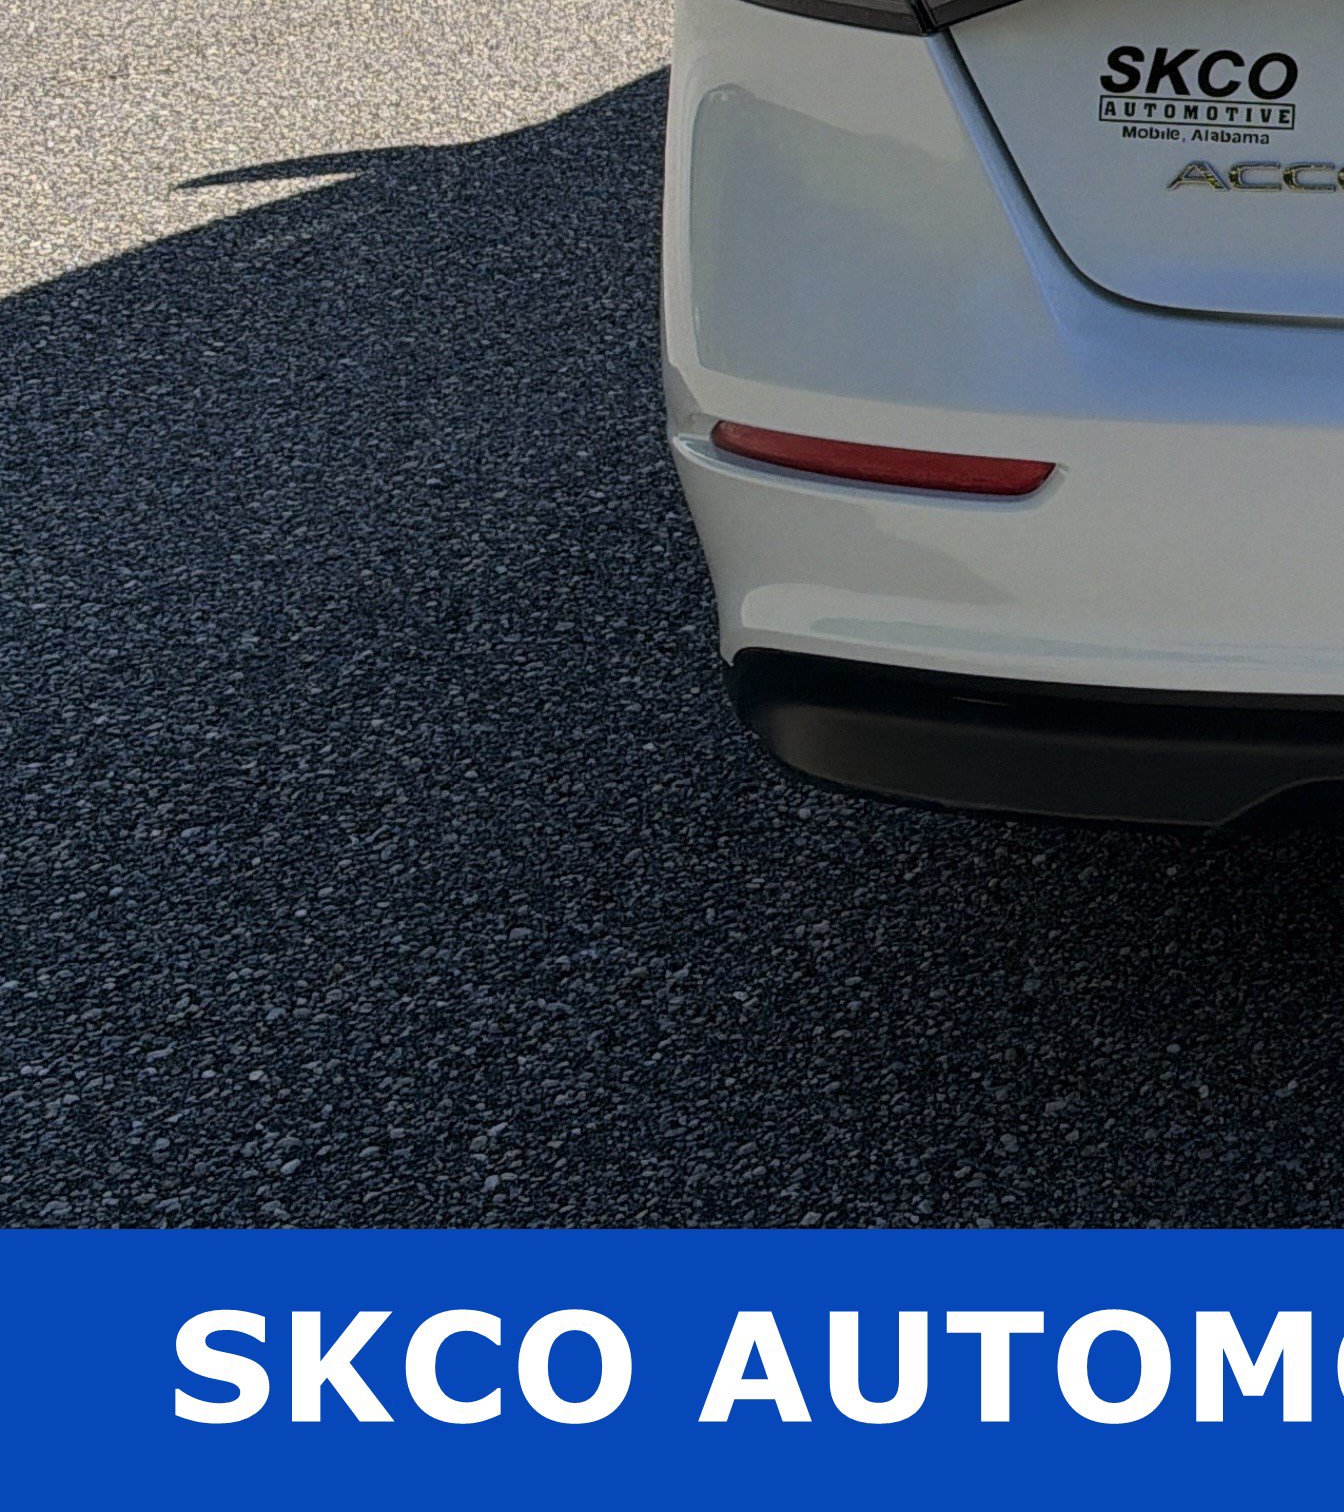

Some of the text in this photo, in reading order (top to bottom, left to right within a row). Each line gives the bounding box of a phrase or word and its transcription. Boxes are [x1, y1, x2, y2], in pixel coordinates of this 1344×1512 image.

[1100, 45, 1298, 100] SKCO
[1104, 101, 1291, 125] AUTOMOTIVE
[1191, 128, 1271, 145] Alabama
